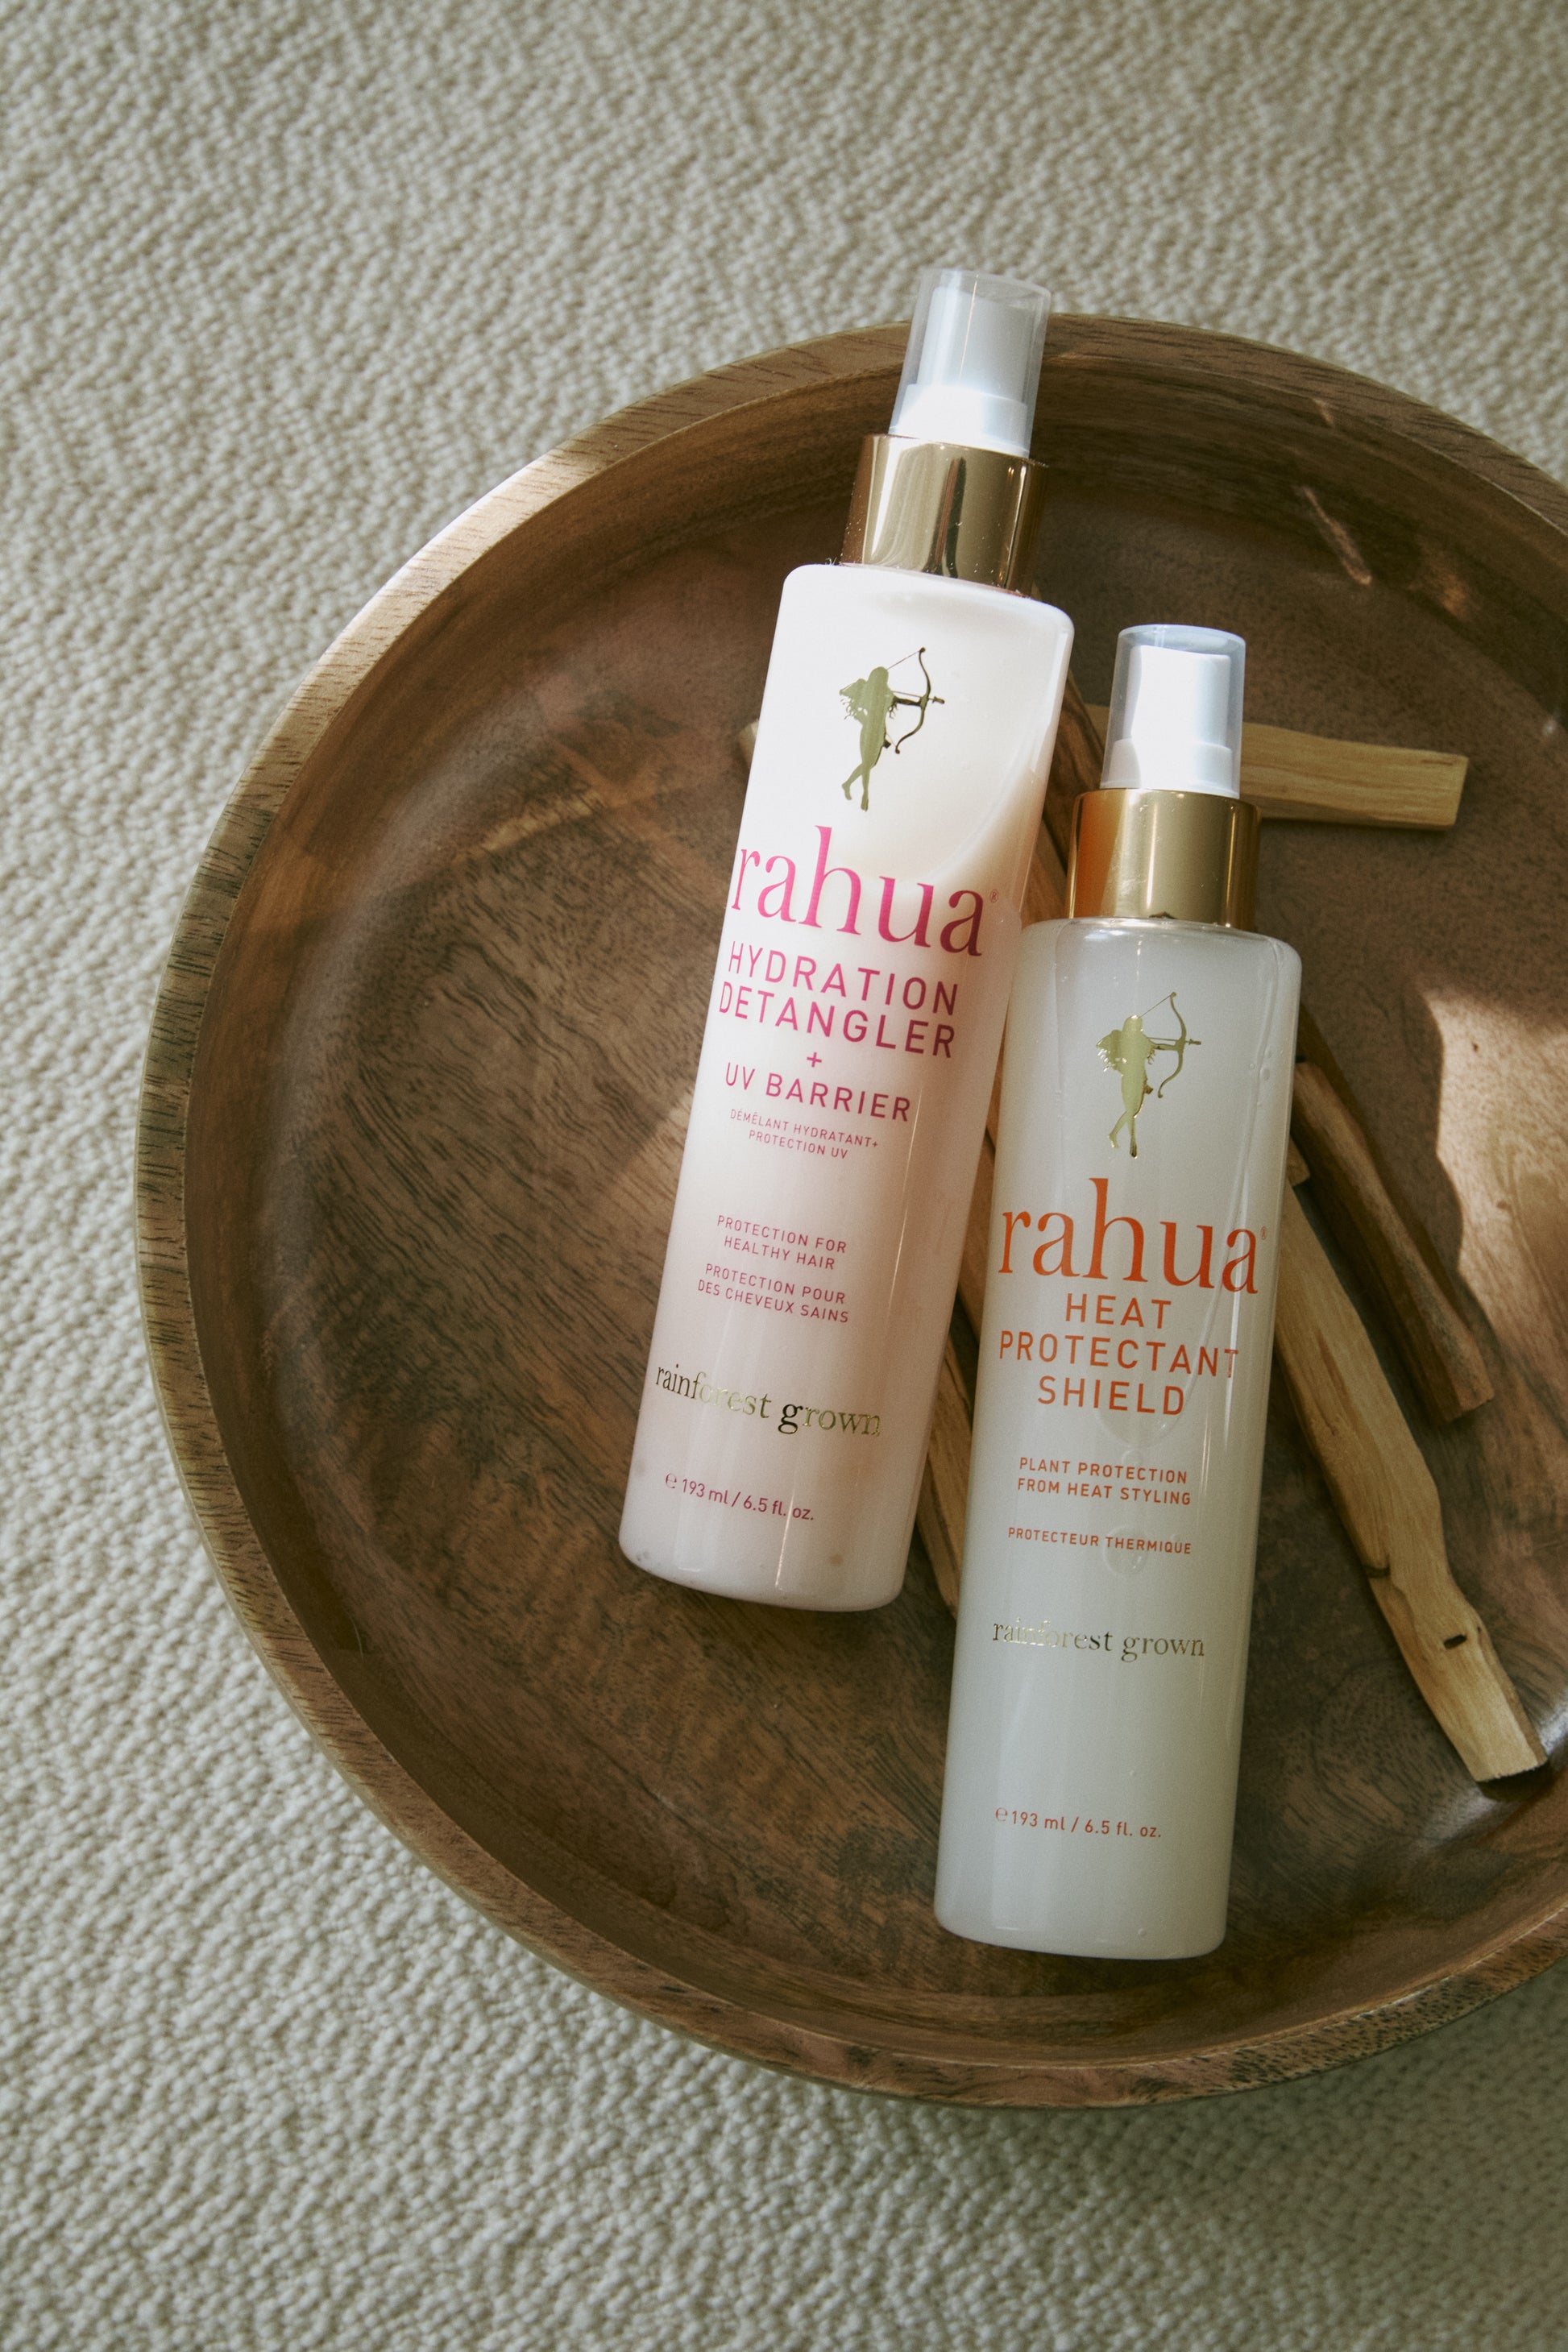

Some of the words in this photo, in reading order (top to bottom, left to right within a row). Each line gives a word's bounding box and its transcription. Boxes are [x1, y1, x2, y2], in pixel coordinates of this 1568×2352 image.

[728, 940, 959, 1017] HYDRATION
[718, 981, 956, 1059] DETANGLER
[807, 1052, 823, 1068] +
[725, 1062, 755, 1090] UV
[765, 1072, 911, 1122] BARRIER
[749, 1130, 826, 1155] PROTECTION
[831, 1147, 848, 1159] UV
[717, 1215, 809, 1247] PROTECTION
[815, 1238, 847, 1254] FOR
[724, 1235, 790, 1262] HEALTHY
[796, 1253, 836, 1271] HAIR
[698, 1280, 720, 1296] DES
[725, 1288, 794, 1314] CHEVEUX
[800, 1305, 849, 1323] SAINS
[706, 1263, 795, 1296] PROTECTION
[802, 1285, 845, 1305] POUR
[1064, 1292, 1172, 1329] HEAT
[999, 1330, 1239, 1379] PROTECTANT
[655, 1363, 772, 1419] rainforest
[778, 1404, 881, 1437] grown
[1037, 1375, 1184, 1416] SHIELD
[1019, 1457, 1071, 1474] PLANT
[1077, 1462, 1188, 1484] PROTECTION
[682, 1479, 706, 1498] 193
[708, 1490, 729, 1505] ml
[743, 1495, 769, 1513] 6.5
[772, 1500, 787, 1516] fl.
[792, 1507, 815, 1521] oz.
[1018, 1478, 1060, 1495] FROM
[1068, 1483, 1113, 1499] HEAT
[1120, 1487, 1191, 1505] STYLING
[1008, 1527, 1100, 1546] PROTECTEUR
[1105, 1537, 1193, 1554] THERMIQUE
[992, 1617, 1114, 1651] rainforest
[1121, 1636, 1205, 1662] grown
[1011, 1811, 1038, 1827] 193
[1044, 1816, 1065, 1831] ml
[1085, 1819, 1110, 1835] 6.5
[1117, 1822, 1133, 1836] fl.
[1139, 1826, 1162, 1838] oz.
